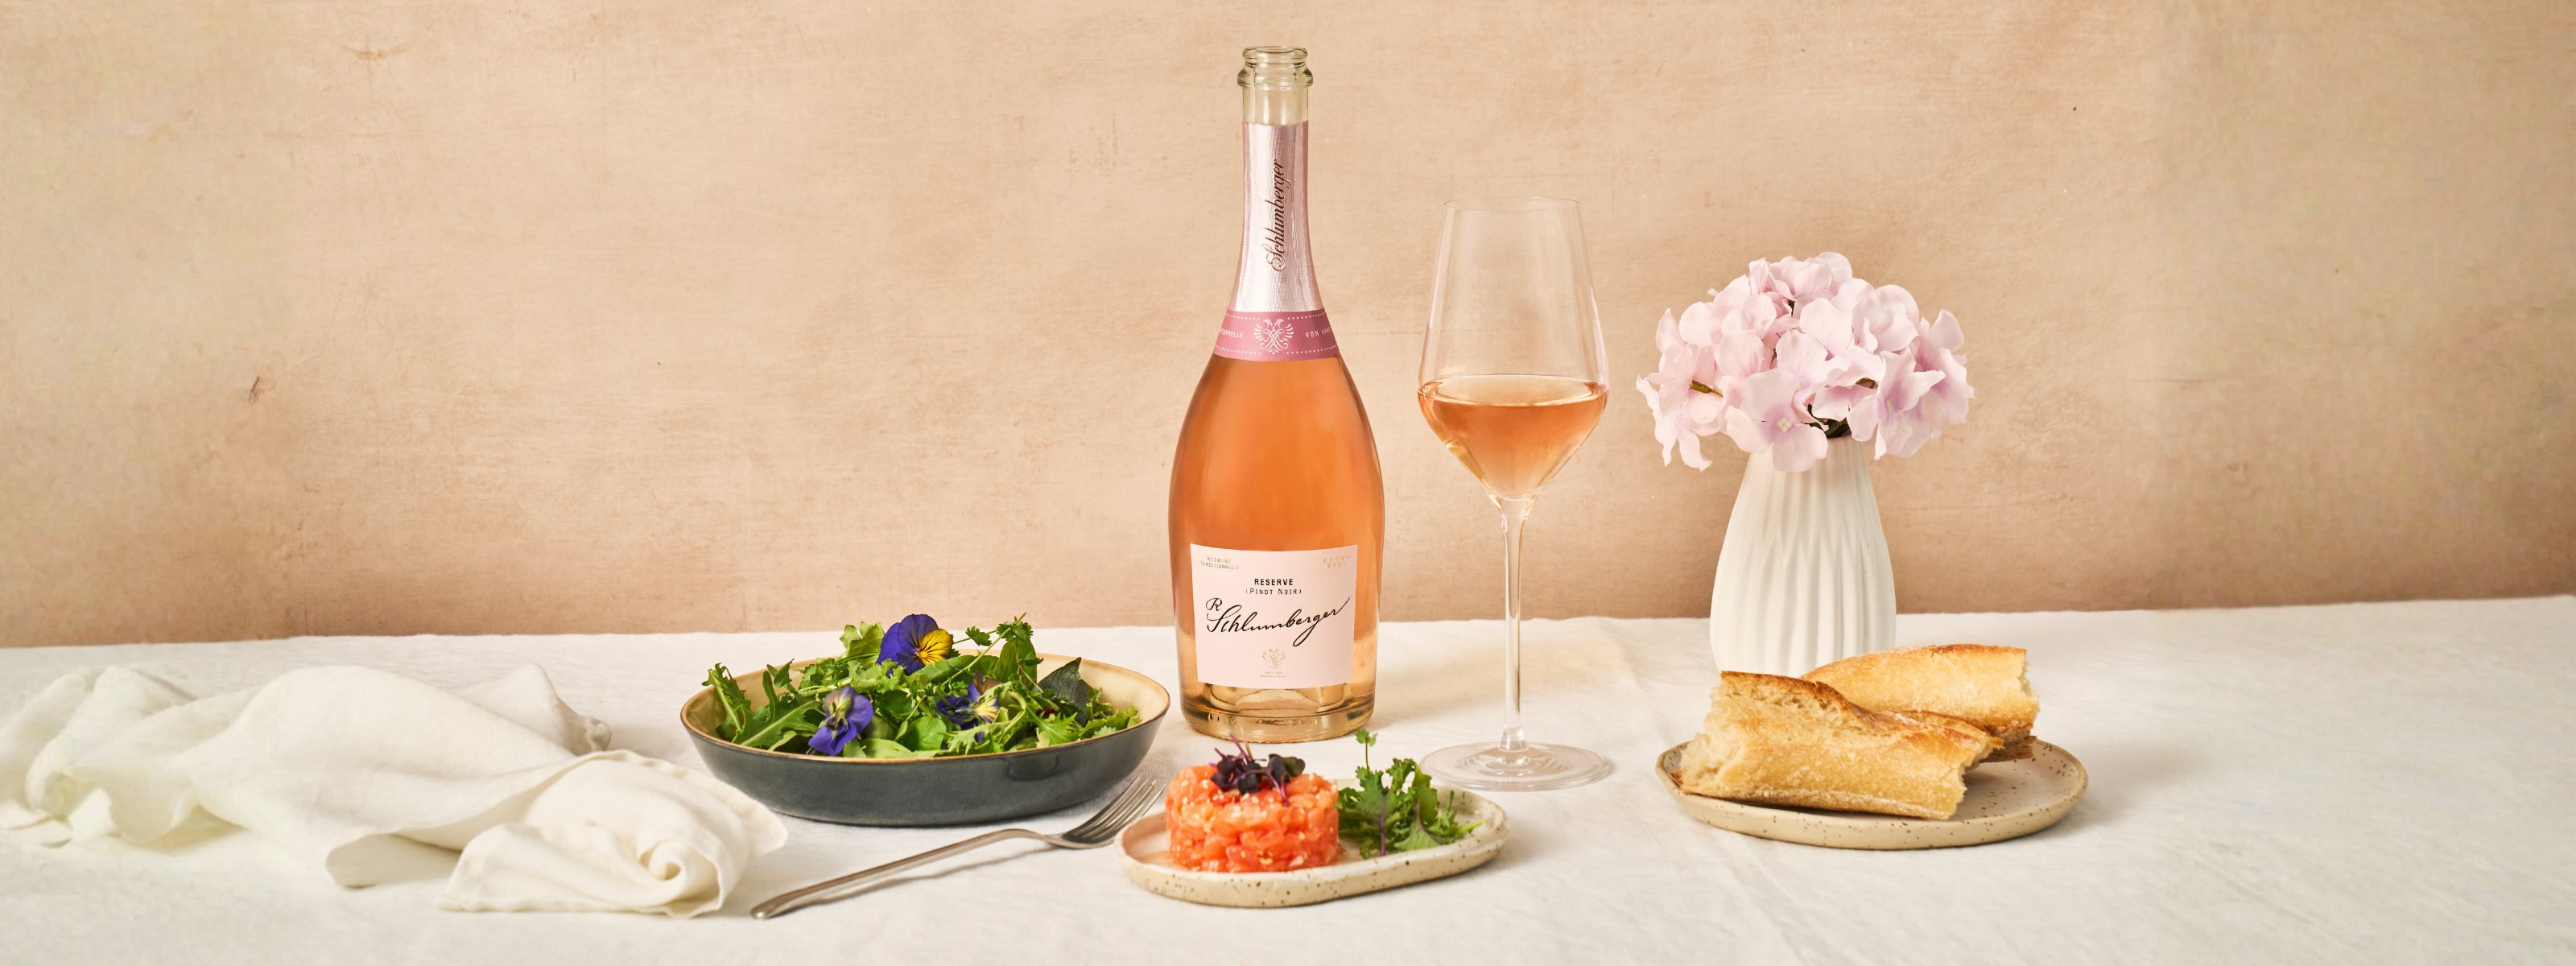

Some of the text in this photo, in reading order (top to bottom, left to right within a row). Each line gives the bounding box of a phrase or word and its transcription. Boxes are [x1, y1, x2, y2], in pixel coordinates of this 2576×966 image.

[1262, 158, 1292, 271] Schlumberger
[1254, 578, 1294, 586] RESERVE
[1207, 597, 1351, 647] Schlumberger
